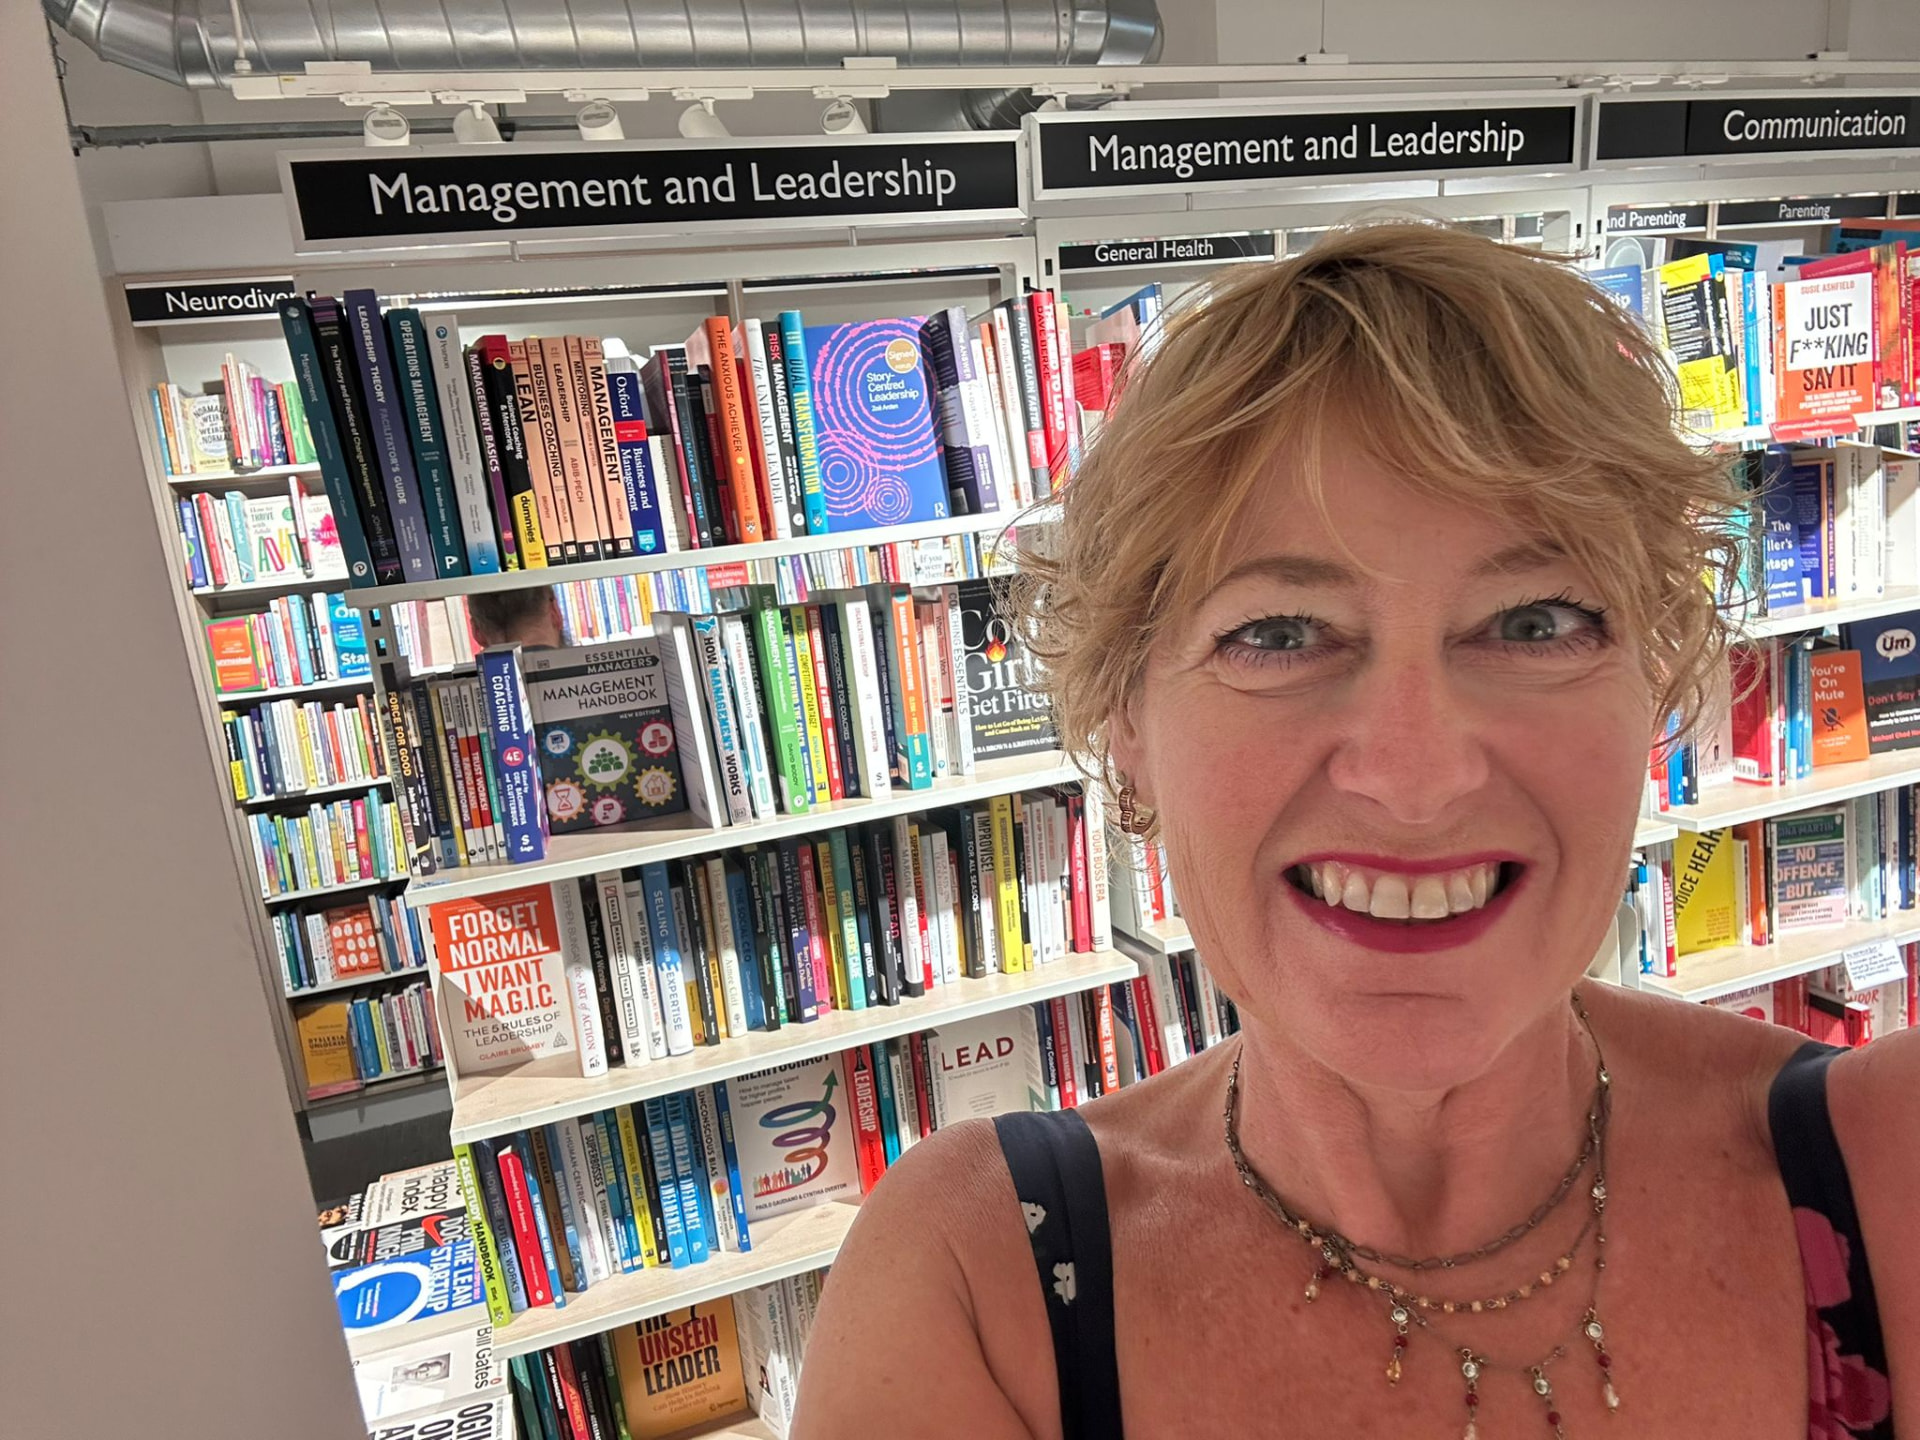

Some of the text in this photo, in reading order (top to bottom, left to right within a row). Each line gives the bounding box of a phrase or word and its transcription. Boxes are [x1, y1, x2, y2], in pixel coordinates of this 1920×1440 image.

[1723, 109, 1906, 141] Communication
[1089, 120, 1525, 179] Management and Leadership
[368, 158, 957, 223] Management and Leadership
[1779, 204, 1830, 220] Parenting
[1629, 210, 1687, 229] Parenting
[1095, 240, 1214, 262] General Health
[1801, 280, 1855, 295] SUSIE ASHFIELD
[1804, 303, 1852, 331] JUST
[330, 344, 341, 358] The
[888, 350, 915, 361] Signed
[1034, 306, 1053, 380] DAVE BERKE
[301, 353, 318, 403] Management
[332, 358, 347, 383] Theory
[399, 319, 433, 443] OPERATIONS MANAGEMENT
[573, 360, 590, 417] MENTORING
[716, 328, 744, 452] THE ANXIOUS ACHIEVER
[767, 332, 793, 445] RISK MANAGEMENT
[866, 372, 896, 384] Story-
[868, 381, 905, 393] Centred
[1017, 316, 1040, 428] FAIL FAST, LEARN FASTER
[1042, 303, 1067, 431] THE NEED TO LEAD
[1803, 363, 1857, 391] SAY IT
[339, 383, 350, 398] and
[342, 398, 357, 426] Practice
[356, 304, 407, 505] LEADERSHIP THEORY FACILITATOR'S GUIDE
[469, 353, 501, 473] MANAGEMENT BASICS
[515, 373, 537, 424] LEAN
[553, 363, 571, 422] LEADERSHIP
[615, 376, 633, 418] Oxford
[869, 389, 920, 403] Leadership
[502, 411, 514, 451] Mentoring
[504, 394, 523, 460] Business Coaching
[531, 363, 562, 478] BUSINESS COACHING
[590, 365, 621, 484] MANAGEMENT
[752, 357, 785, 504] The UNLIKELY LEADER
[789, 357, 823, 495] DUAL TRANSFORMATION
[351, 436, 366, 464] Change
[358, 463, 377, 508] Management
[570, 457, 585, 503] ABIB-PECH
[621, 448, 639, 512] Management
[632, 447, 653, 509] Business and
[519, 494, 537, 543] dummies
[1772, 520, 1791, 532] The
[335, 606, 359, 619] On
[762, 595, 782, 670] MANAGEMENT
[585, 647, 650, 663] ESSENTIAL
[587, 657, 653, 674] MANAGERS
[949, 592, 969, 715] COACHING ESSENTIALS
[1882, 634, 1911, 651] Um
[543, 674, 655, 702] MANAGEMENT
[1810, 662, 1846, 678] You're
[1819, 677, 1838, 688] On
[490, 675, 510, 732] COACHING
[578, 689, 657, 710] HANDBOOK
[704, 636, 742, 796] HOW MANAGEMENT WORKS
[967, 694, 999, 717] Get
[1815, 690, 1845, 702] Mute
[1868, 690, 1916, 706] Don't Say
[388, 691, 412, 777] FORCE FOR GOOD
[505, 751, 521, 762] 4E
[977, 816, 994, 873] IMPROVISE!
[1092, 828, 1106, 902] YOUR BOSS ERA
[1795, 846, 1816, 862] NO
[1674, 825, 1727, 911] VOICE HEAR
[1777, 862, 1839, 882] OFFENCE,
[1786, 882, 1828, 899] BUT...
[448, 901, 538, 941] FORGET
[449, 928, 549, 968] NORMAL
[652, 890, 683, 1031] SELLING YOUR EXPERTISE
[463, 958, 543, 996] I WANT
[463, 1011, 561, 1039] THE 5 RULES OF
[464, 983, 557, 1024] M.A.G.I.C.
[573, 966, 596, 1050] the ART of ACTION
[475, 1023, 554, 1047] LEADERSHIP
[941, 1036, 1014, 1071] LEAD
[854, 1069, 877, 1132] LEADERSHIP
[695, 1091, 719, 1177] UNCONSCIOUS BIAS
[585, 1134, 605, 1188] SUPERBOSSES
[401, 1178, 422, 1215] Index
[425, 1168, 449, 1211] Happy
[659, 1183, 683, 1236] INFLUENCE
[679, 1178, 703, 1230] INFLUENCE
[458, 1157, 495, 1281] CASE STUDY HANDBOOK
[485, 1171, 521, 1293] HOW THE FUTURE WORKS
[427, 1245, 453, 1312] STARTUP
[451, 1238, 473, 1307] THE LEAN
[474, 1326, 493, 1389] Bill Gates
[638, 1313, 719, 1366] UNSEEN
[643, 1345, 721, 1396] LEADER
